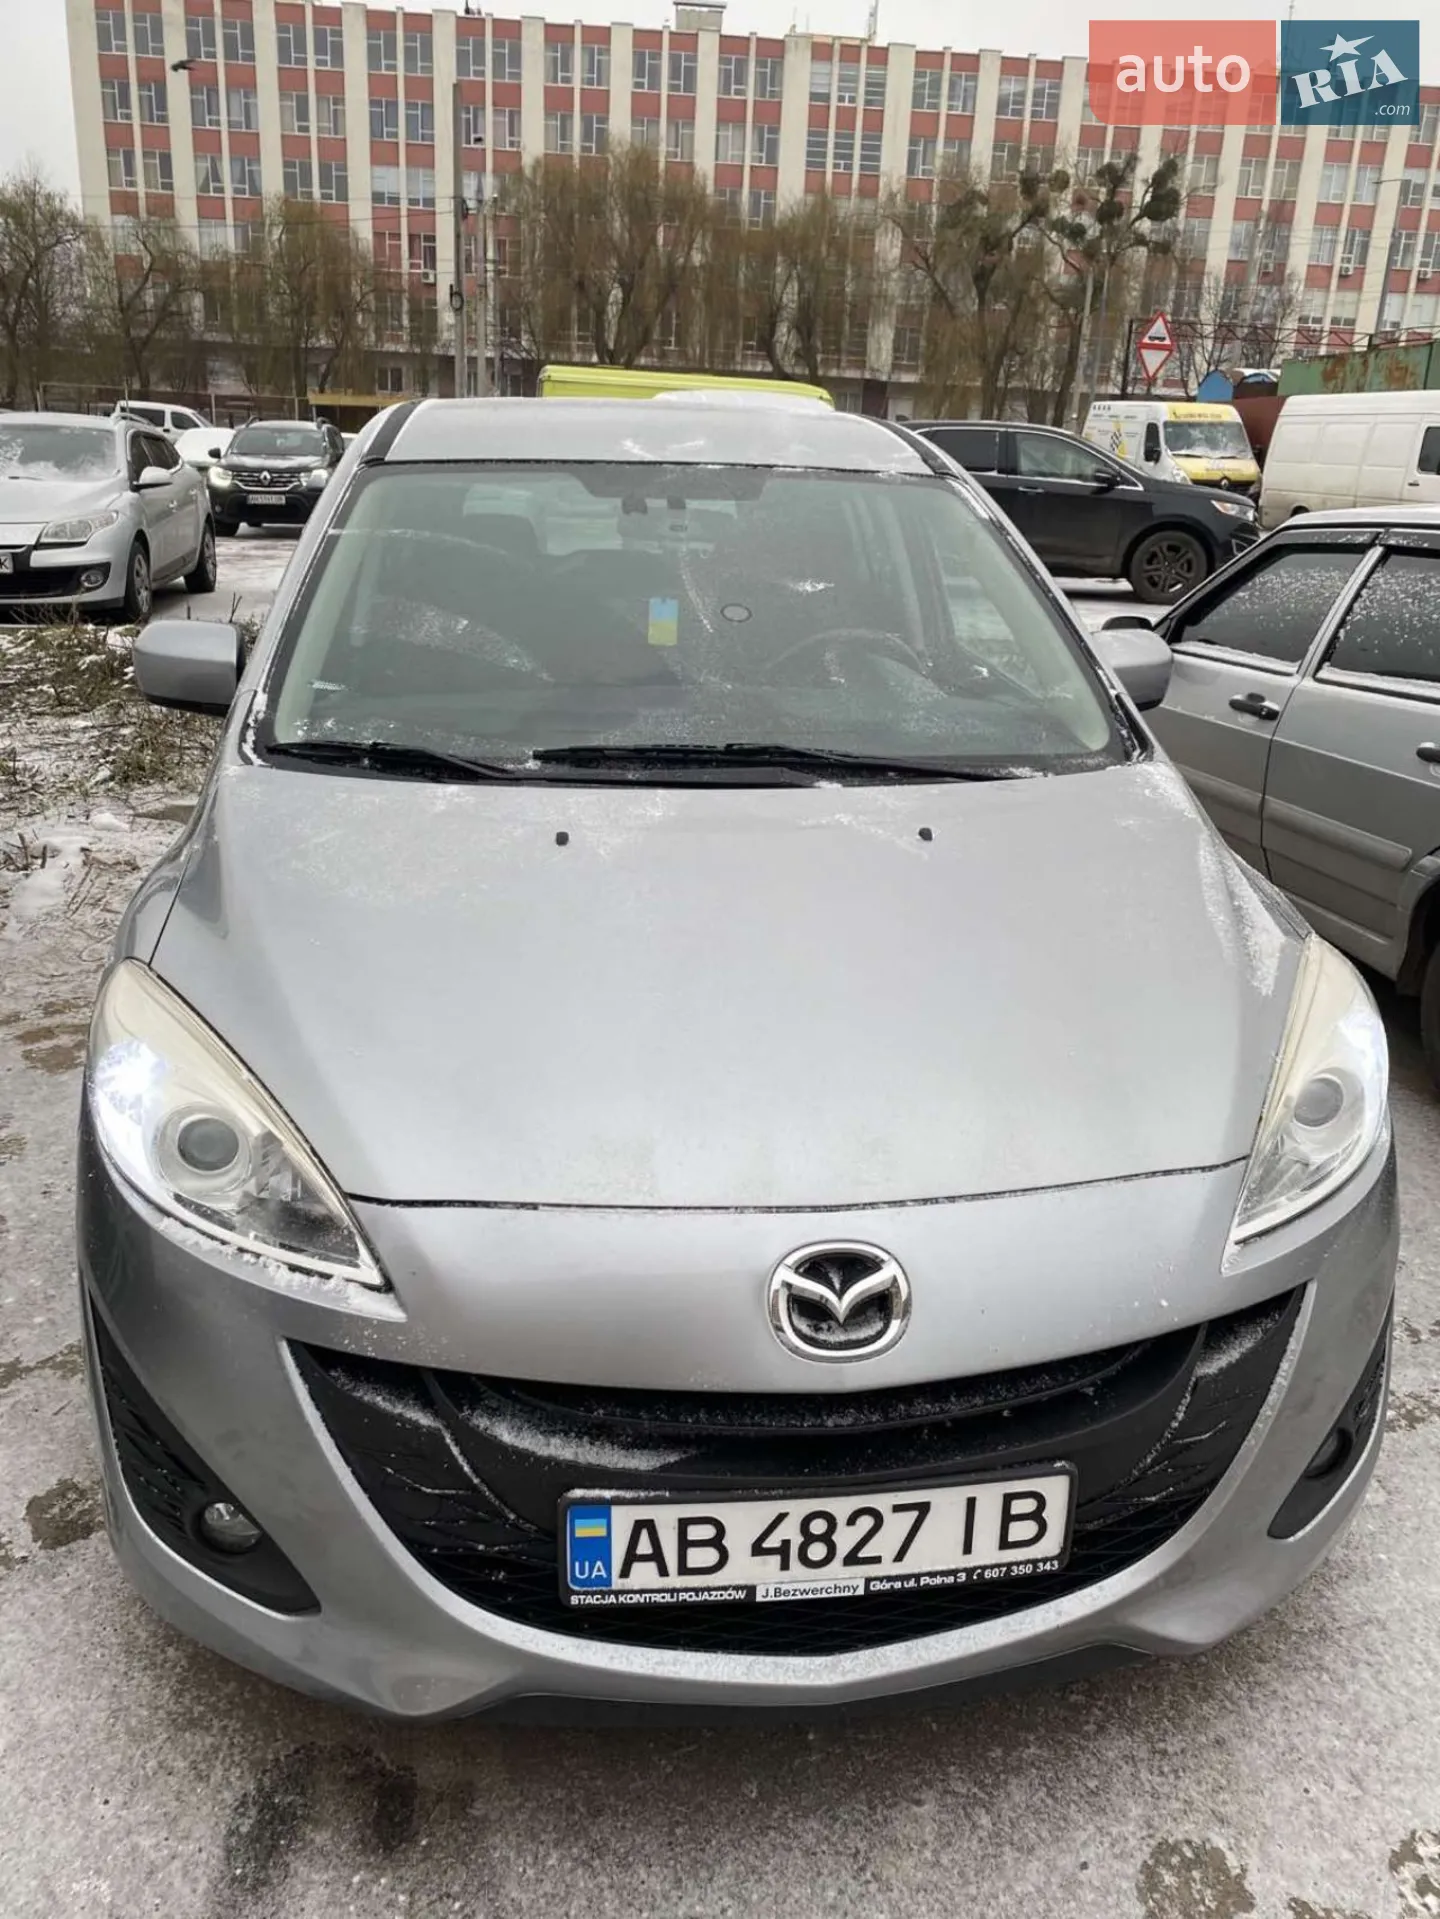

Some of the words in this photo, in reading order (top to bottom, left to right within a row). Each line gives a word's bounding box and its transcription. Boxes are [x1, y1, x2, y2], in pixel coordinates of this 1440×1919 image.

[618, 1515, 729, 1579] AB
[751, 1501, 931, 1571] 4827
[962, 1490, 1048, 1555] IB
[570, 1593, 617, 1605] STACJA
[618, 1591, 677, 1604] KONTROLI
[679, 1588, 747, 1601] POJAZDÓW
[761, 1583, 860, 1599] J.Bezwerchny
[869, 1578, 901, 1591] Góra
[904, 1575, 918, 1588] ul.
[920, 1574, 955, 1587] Polna
[956, 1572, 966, 1583] 3
[983, 1567, 1007, 1579] 607
[1010, 1564, 1033, 1576] 350
[1036, 1560, 1059, 1573] 343
[574, 1560, 608, 1579] UA
